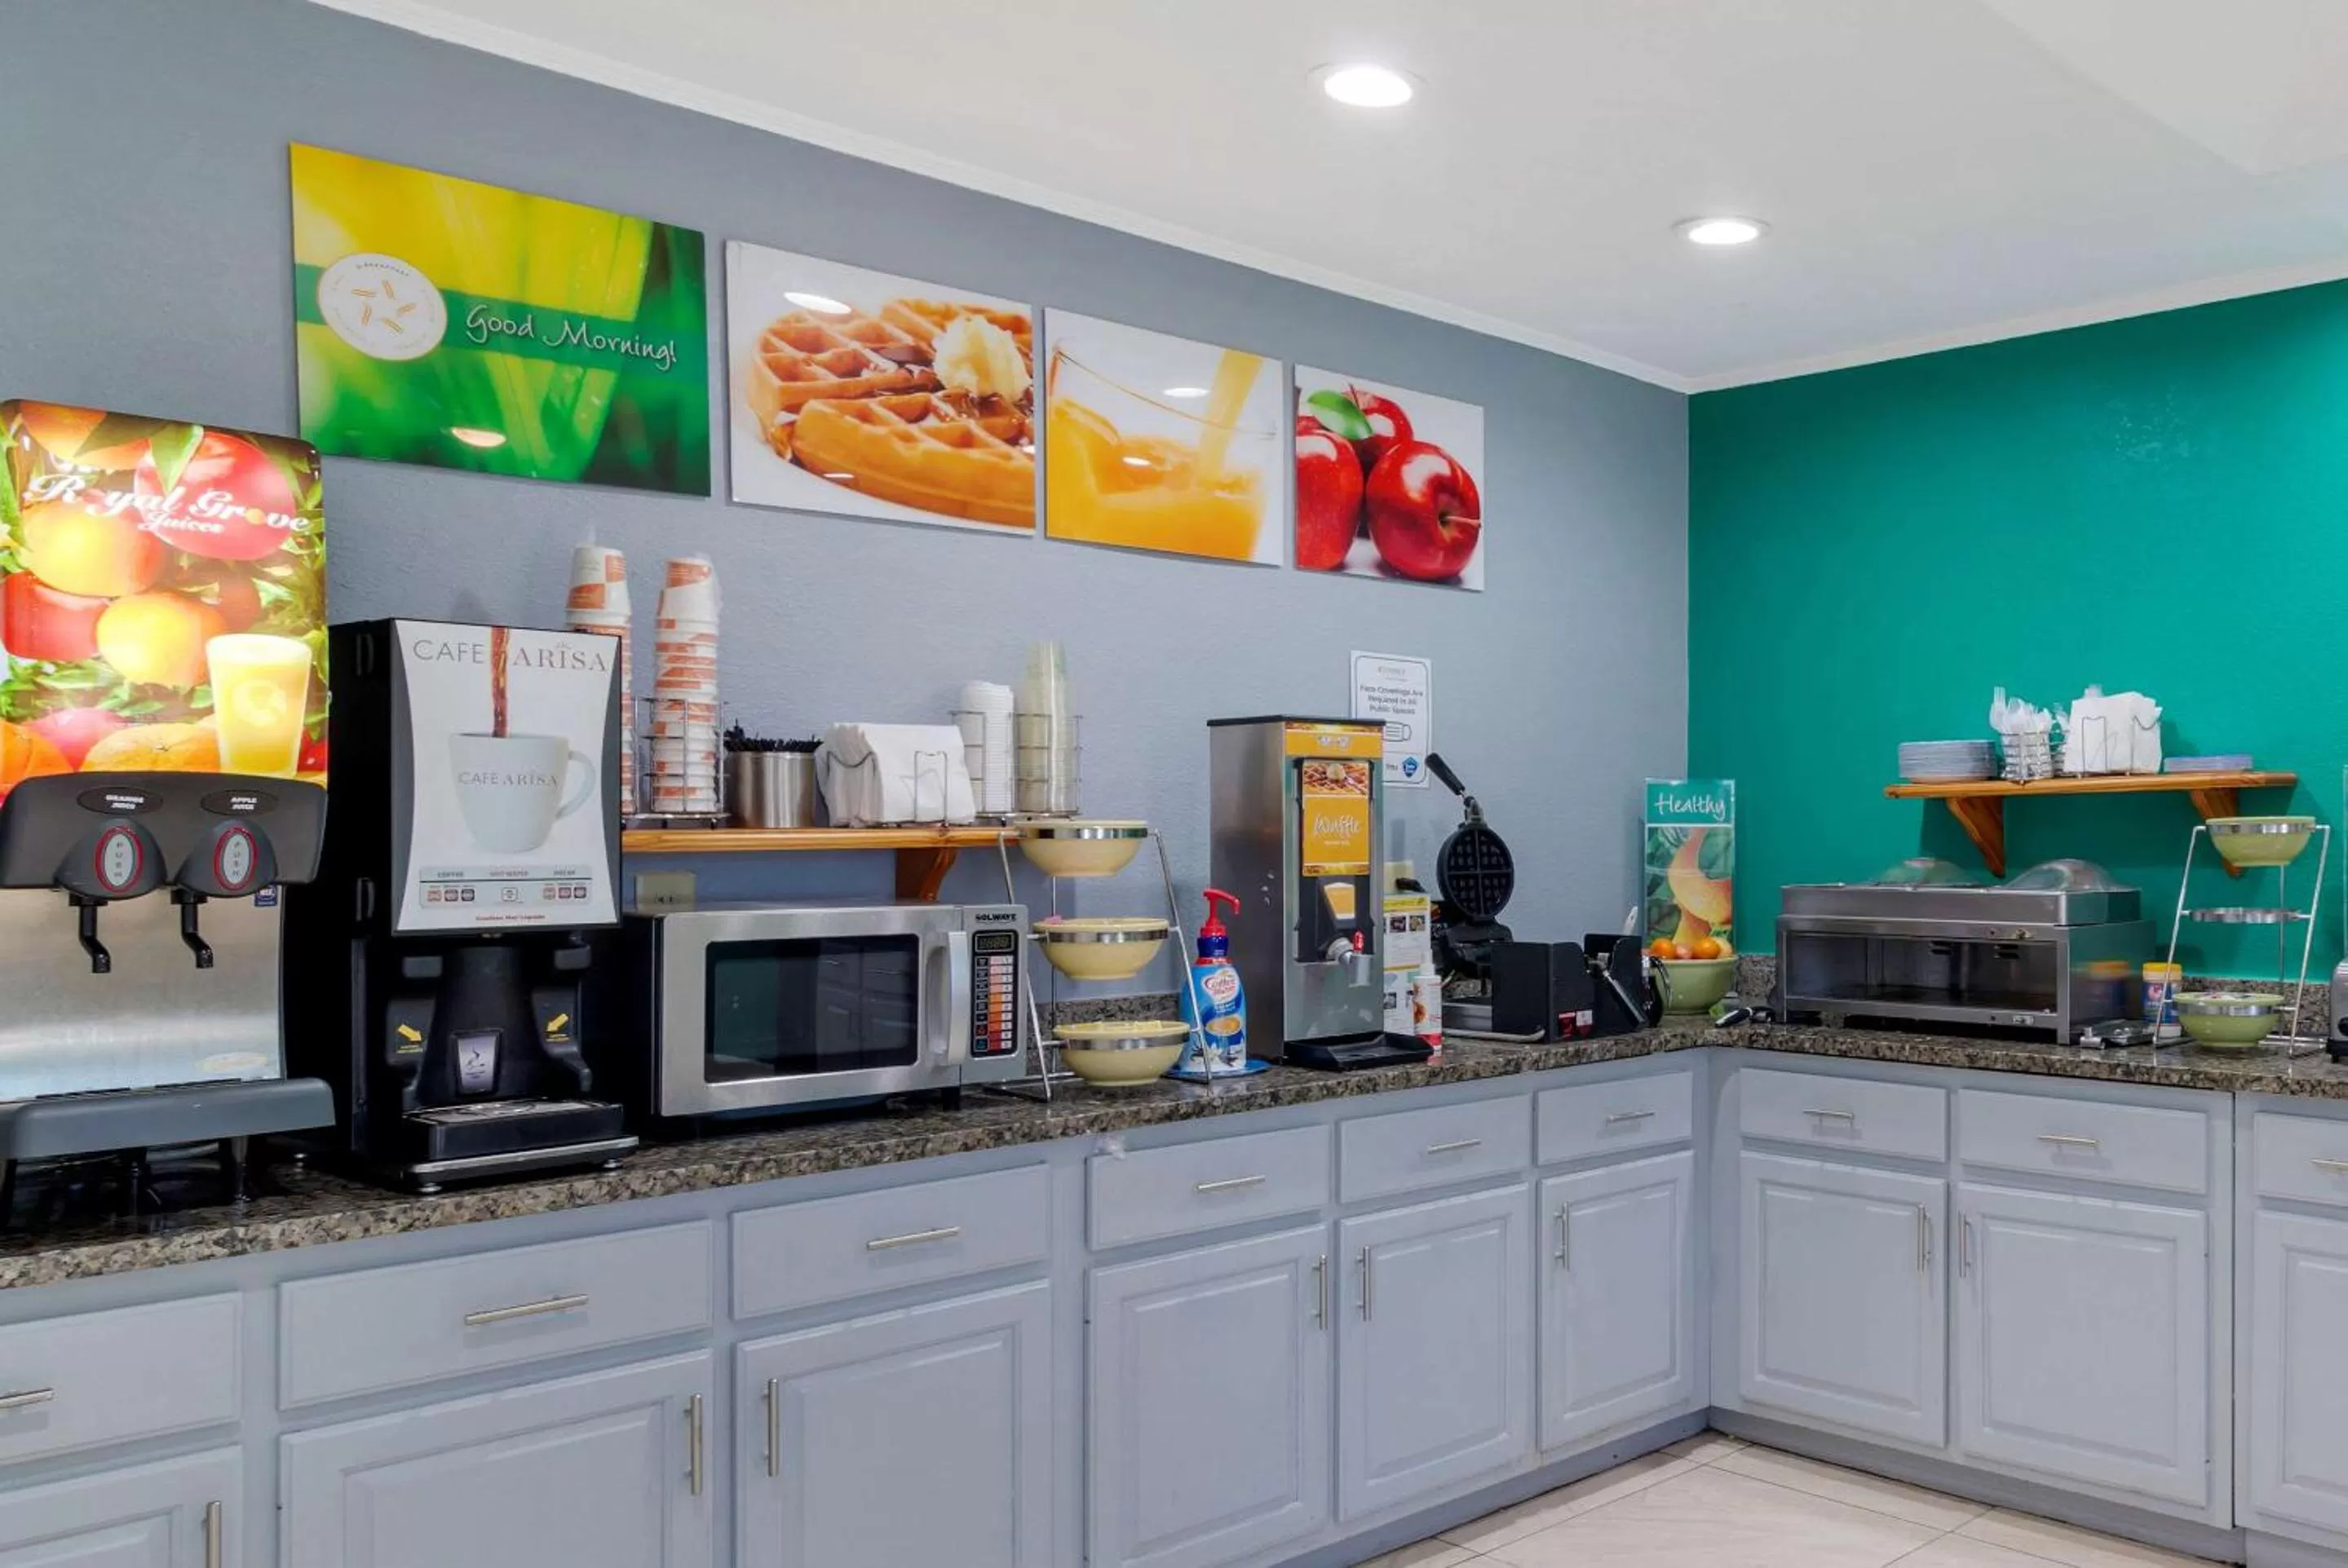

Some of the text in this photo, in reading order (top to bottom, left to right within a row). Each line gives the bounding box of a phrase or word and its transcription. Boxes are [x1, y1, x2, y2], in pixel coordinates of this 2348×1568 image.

[465, 303, 677, 370] Good Morning!
[138, 510, 226, 535] Juices
[413, 639, 607, 672] CAFE ARISA
[458, 771, 560, 790] CAFE ARISA
[1654, 792, 1726, 821] Healthy
